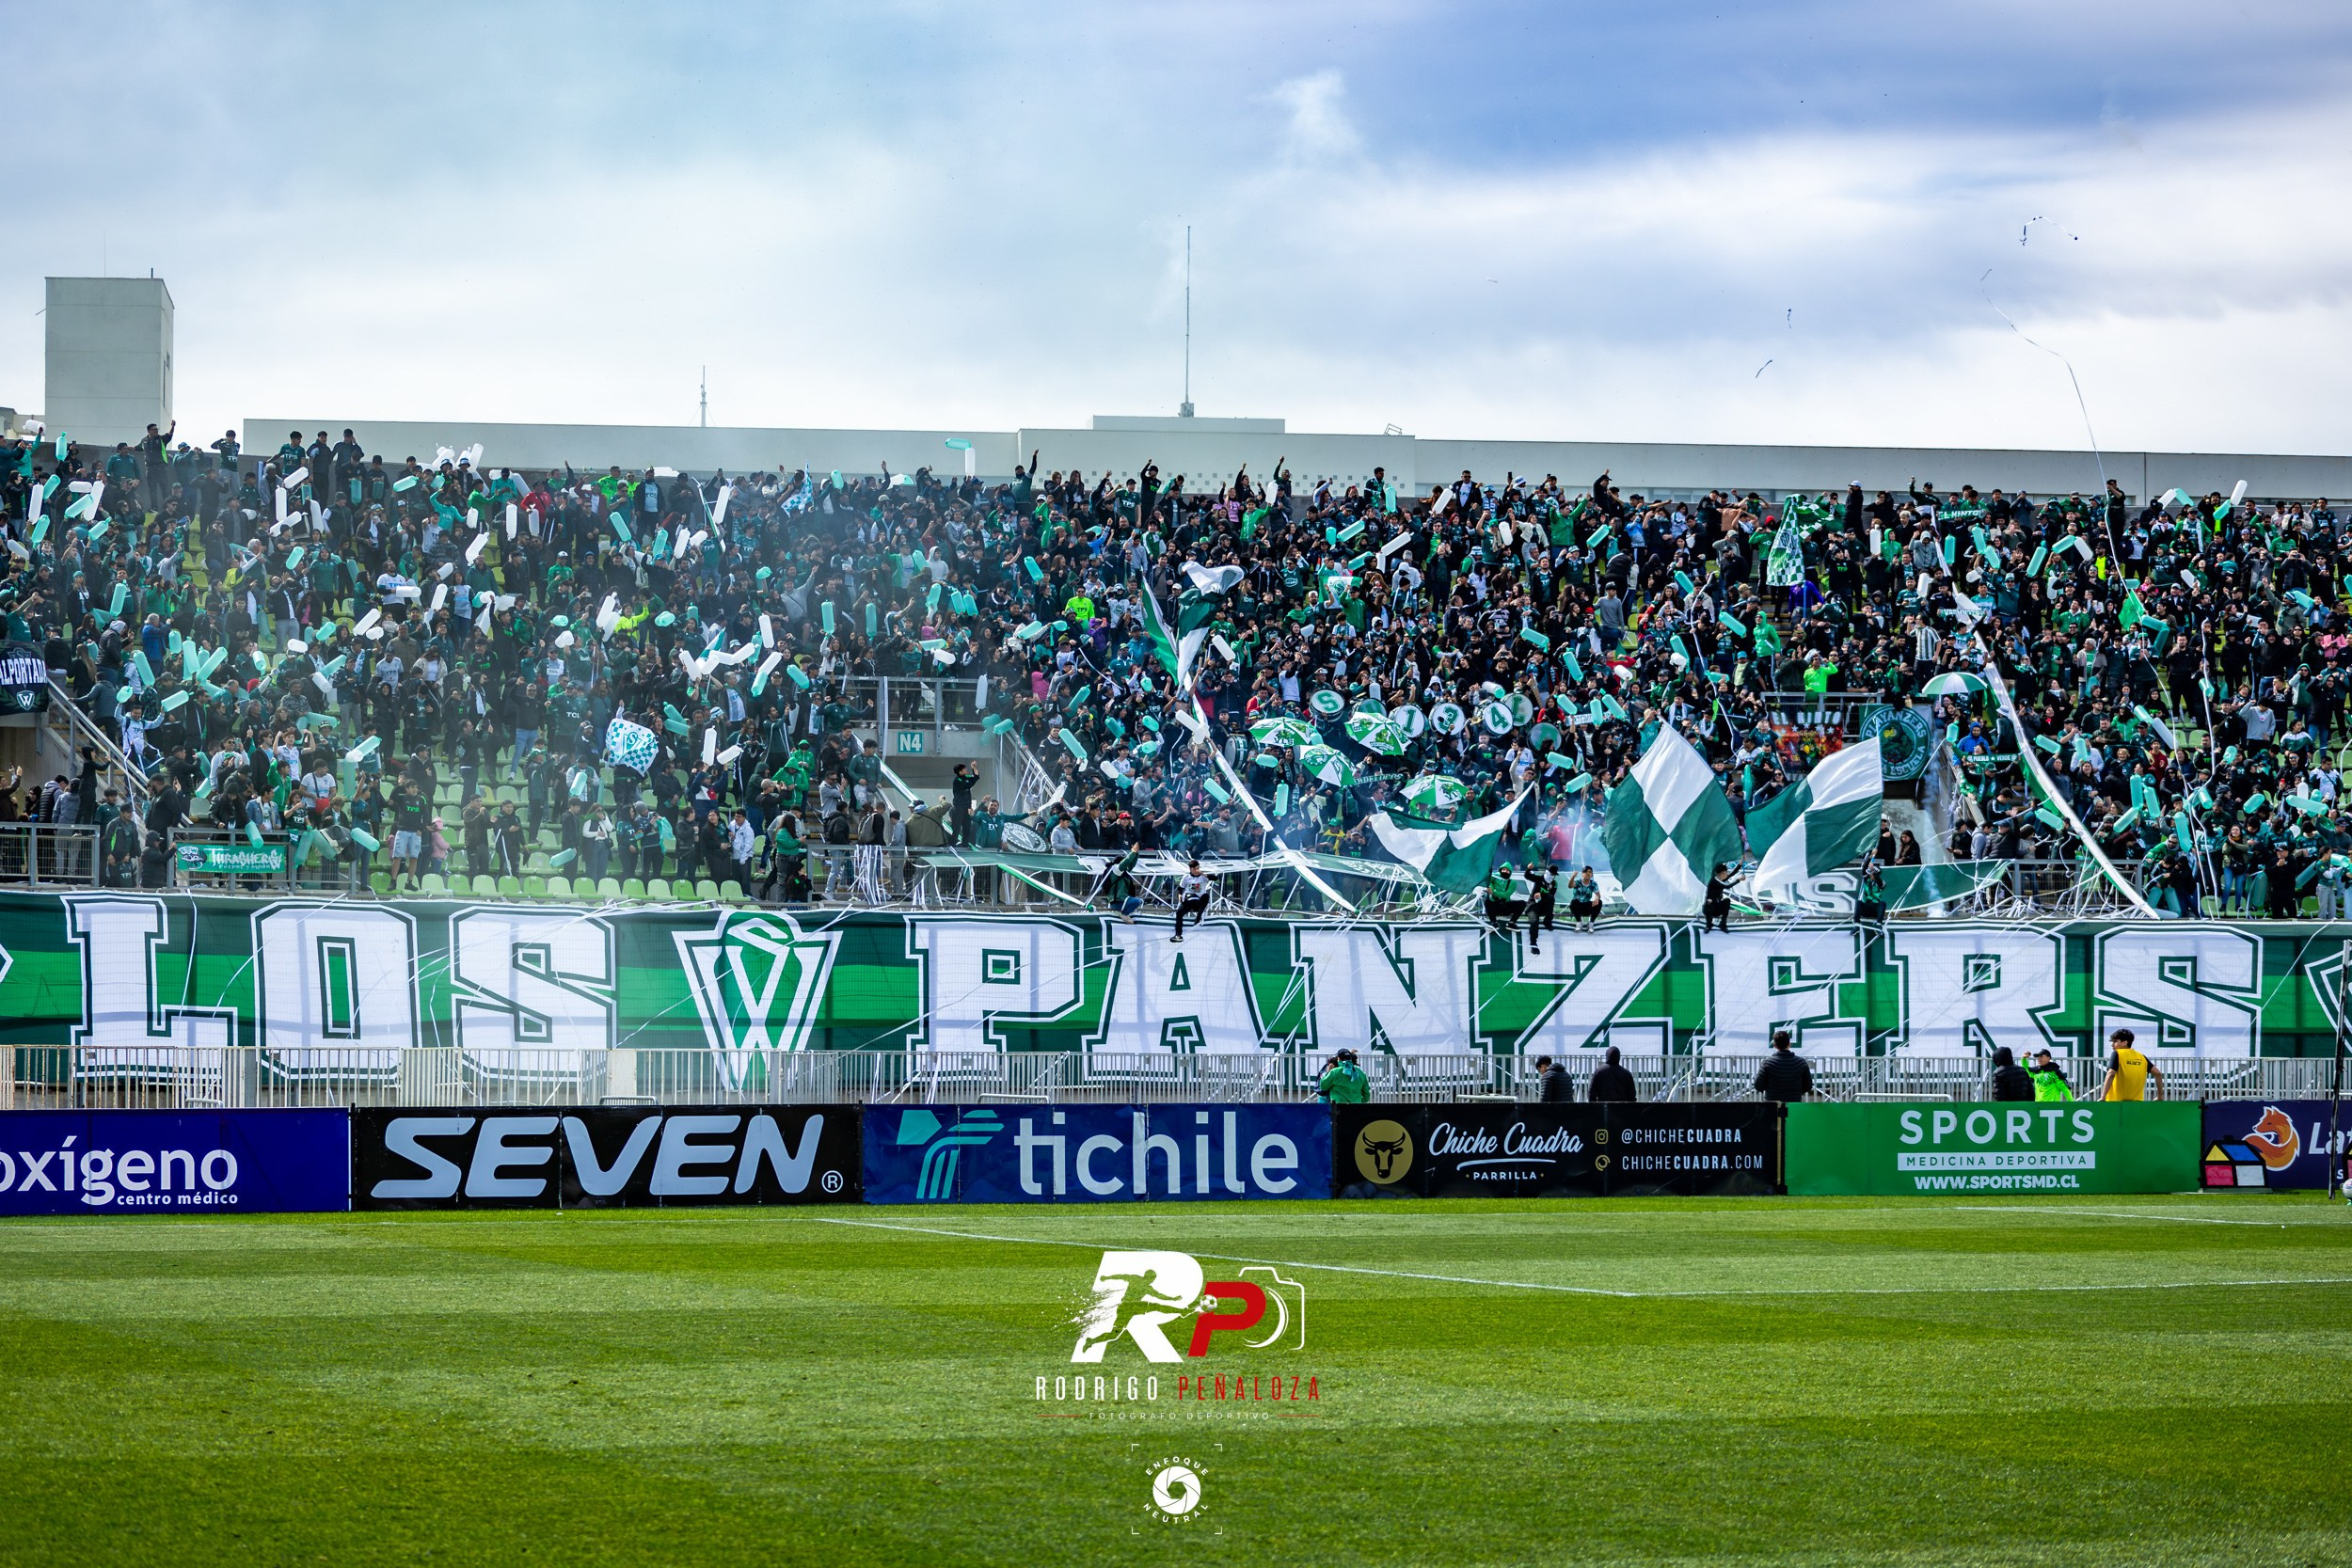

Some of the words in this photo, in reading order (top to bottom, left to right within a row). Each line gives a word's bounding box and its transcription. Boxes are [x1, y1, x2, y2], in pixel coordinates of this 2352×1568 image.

[1317, 692, 1339, 712] S
[1403, 707, 1417, 735] 1
[1491, 705, 1510, 730] 4
[899, 734, 922, 752] N4
[1890, 745, 1927, 776] ESCUELA
[60, 895, 617, 1082] LOS
[903, 914, 2264, 1091] PANZERS
[1621, 1128, 1742, 1144] @CHICHECUADRA
[1899, 1109, 2094, 1145] SPORTS
[1429, 1122, 1498, 1156] Chiche
[1503, 1122, 1584, 1155] Cuadra
[371, 1114, 824, 1199] SEVEN
[1014, 1111, 1299, 1198] tichile
[1622, 1154, 1763, 1170] CHICHECUADRA.COM
[1906, 1156, 1986, 1166] MEDICINA
[1995, 1155, 2087, 1165] DEPORTIVA
[1473, 1171, 1537, 1180] PARRILLA
[1914, 1174, 2080, 1190] WWW.SPORTSMD.CL
[117, 1193, 171, 1205] centro
[178, 1191, 238, 1205] médico
